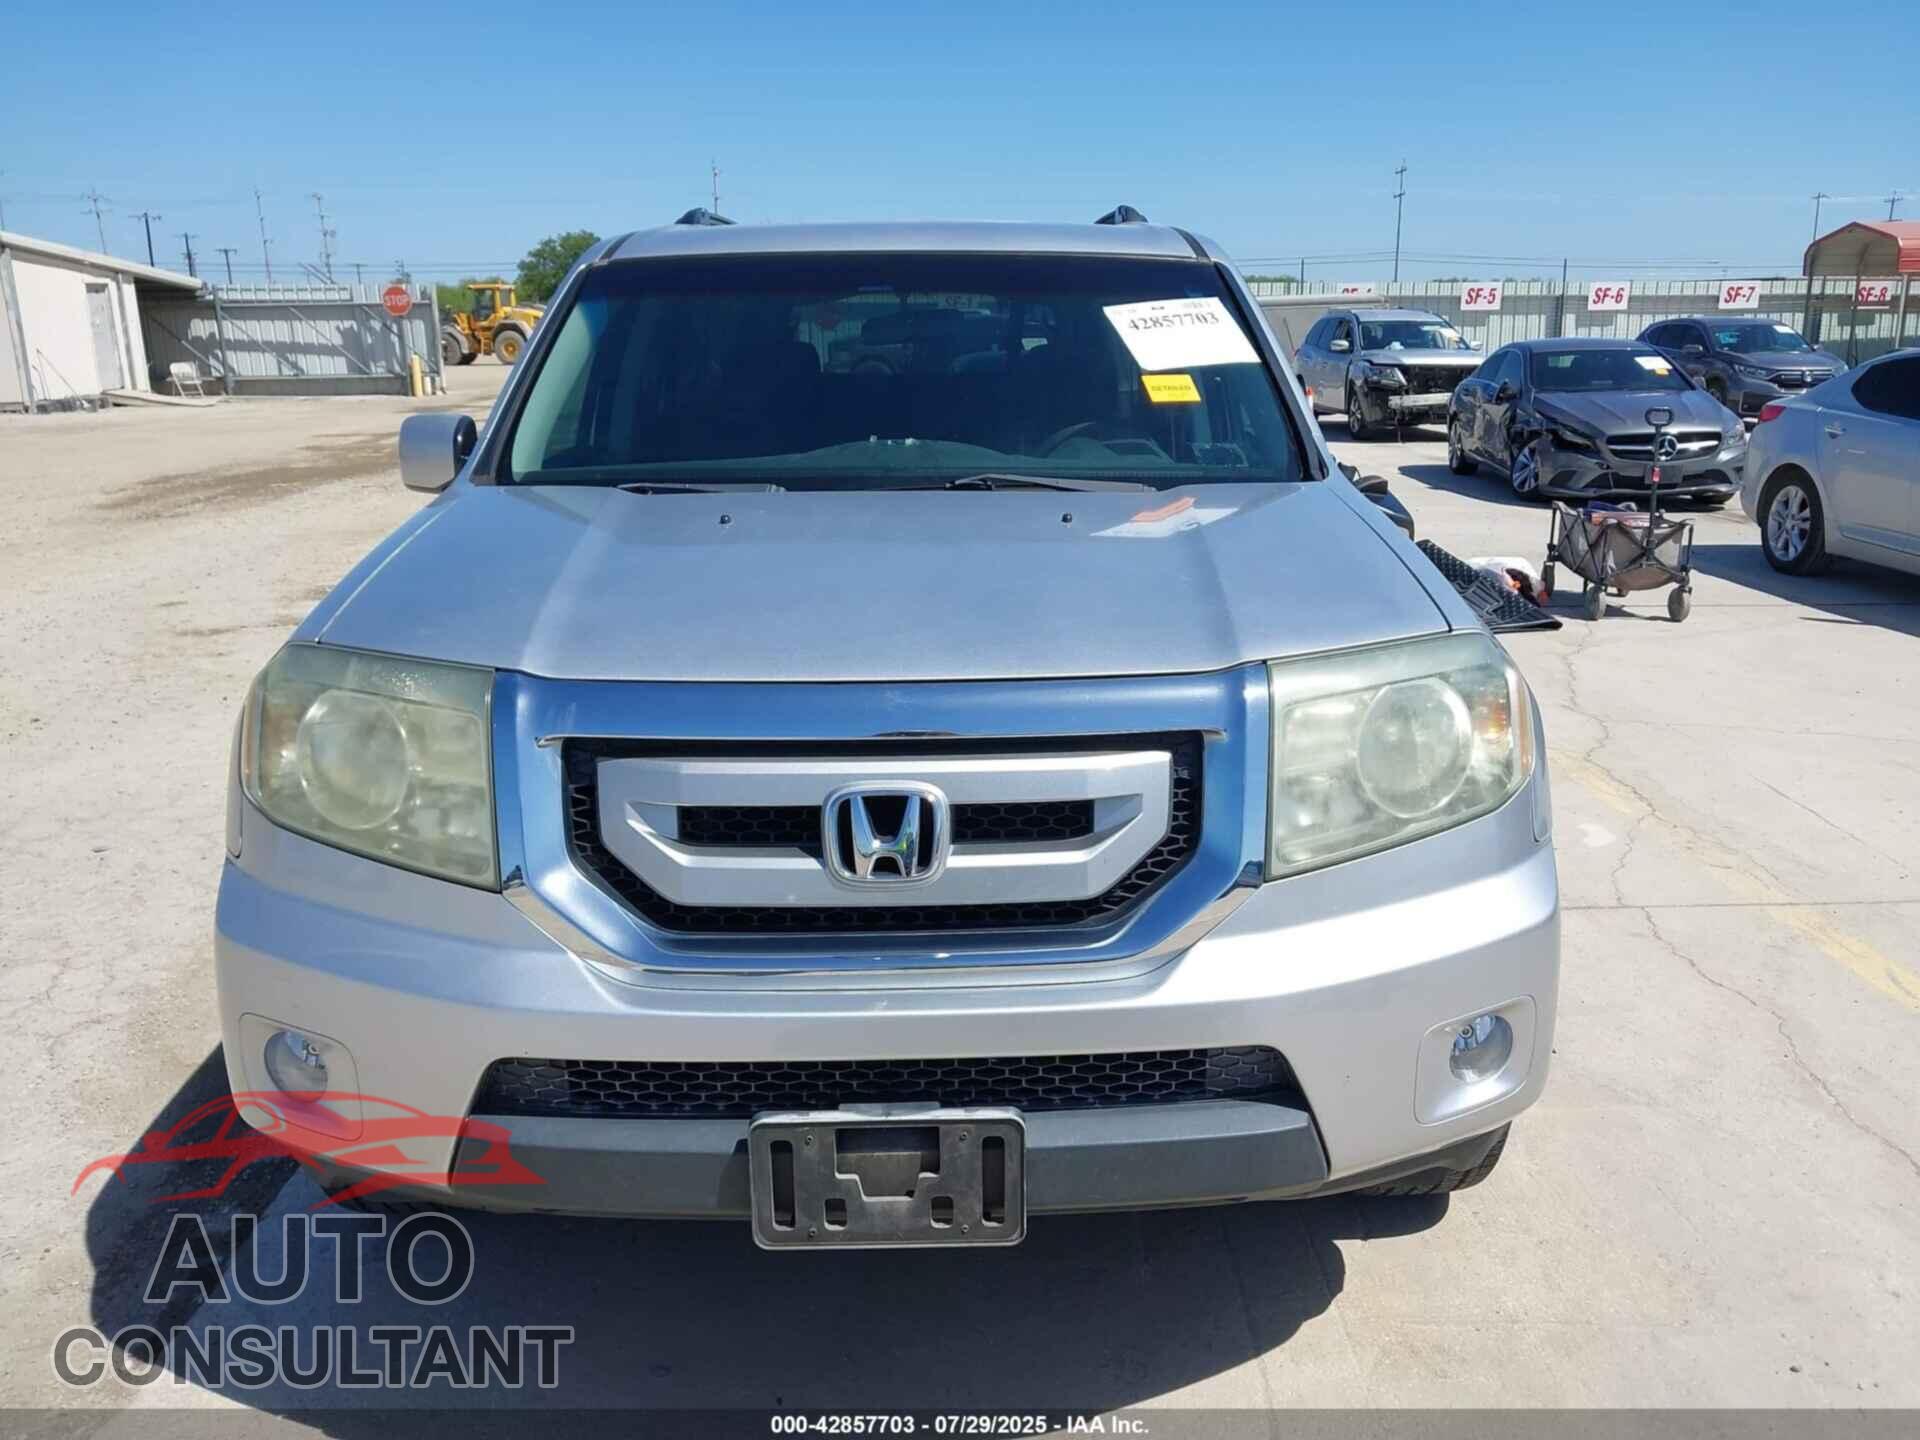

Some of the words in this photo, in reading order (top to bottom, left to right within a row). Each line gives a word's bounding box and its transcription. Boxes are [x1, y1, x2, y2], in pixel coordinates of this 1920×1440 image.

[384, 294, 409, 305] STOP
[1465, 287, 1498, 305] SF-5
[1592, 287, 1625, 305] SF-6
[1724, 286, 1757, 304] SF-7
[1858, 286, 1889, 305] SF-8
[1128, 312, 1220, 331] 42857703
